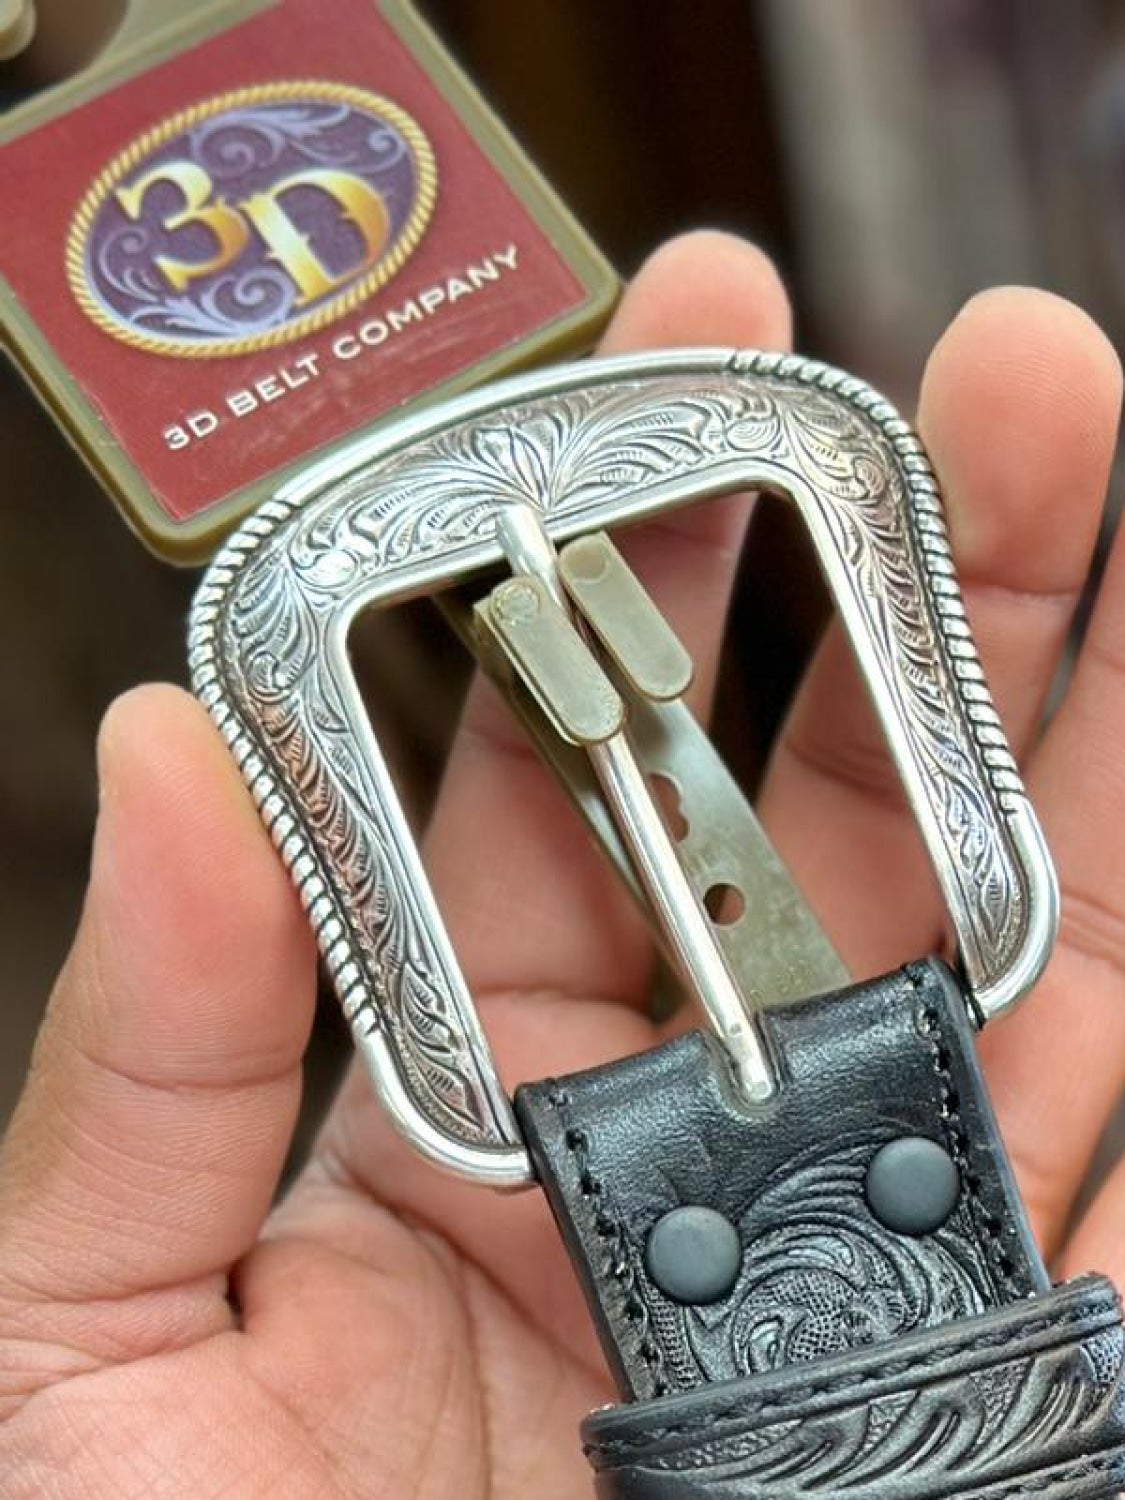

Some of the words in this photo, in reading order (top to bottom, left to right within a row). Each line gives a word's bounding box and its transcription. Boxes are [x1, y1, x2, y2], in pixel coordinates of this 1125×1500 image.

[116, 161, 390, 307] 3D
[163, 409, 219, 451] 3D
[226, 354, 320, 416] BELT
[332, 245, 522, 361] COMPANY
